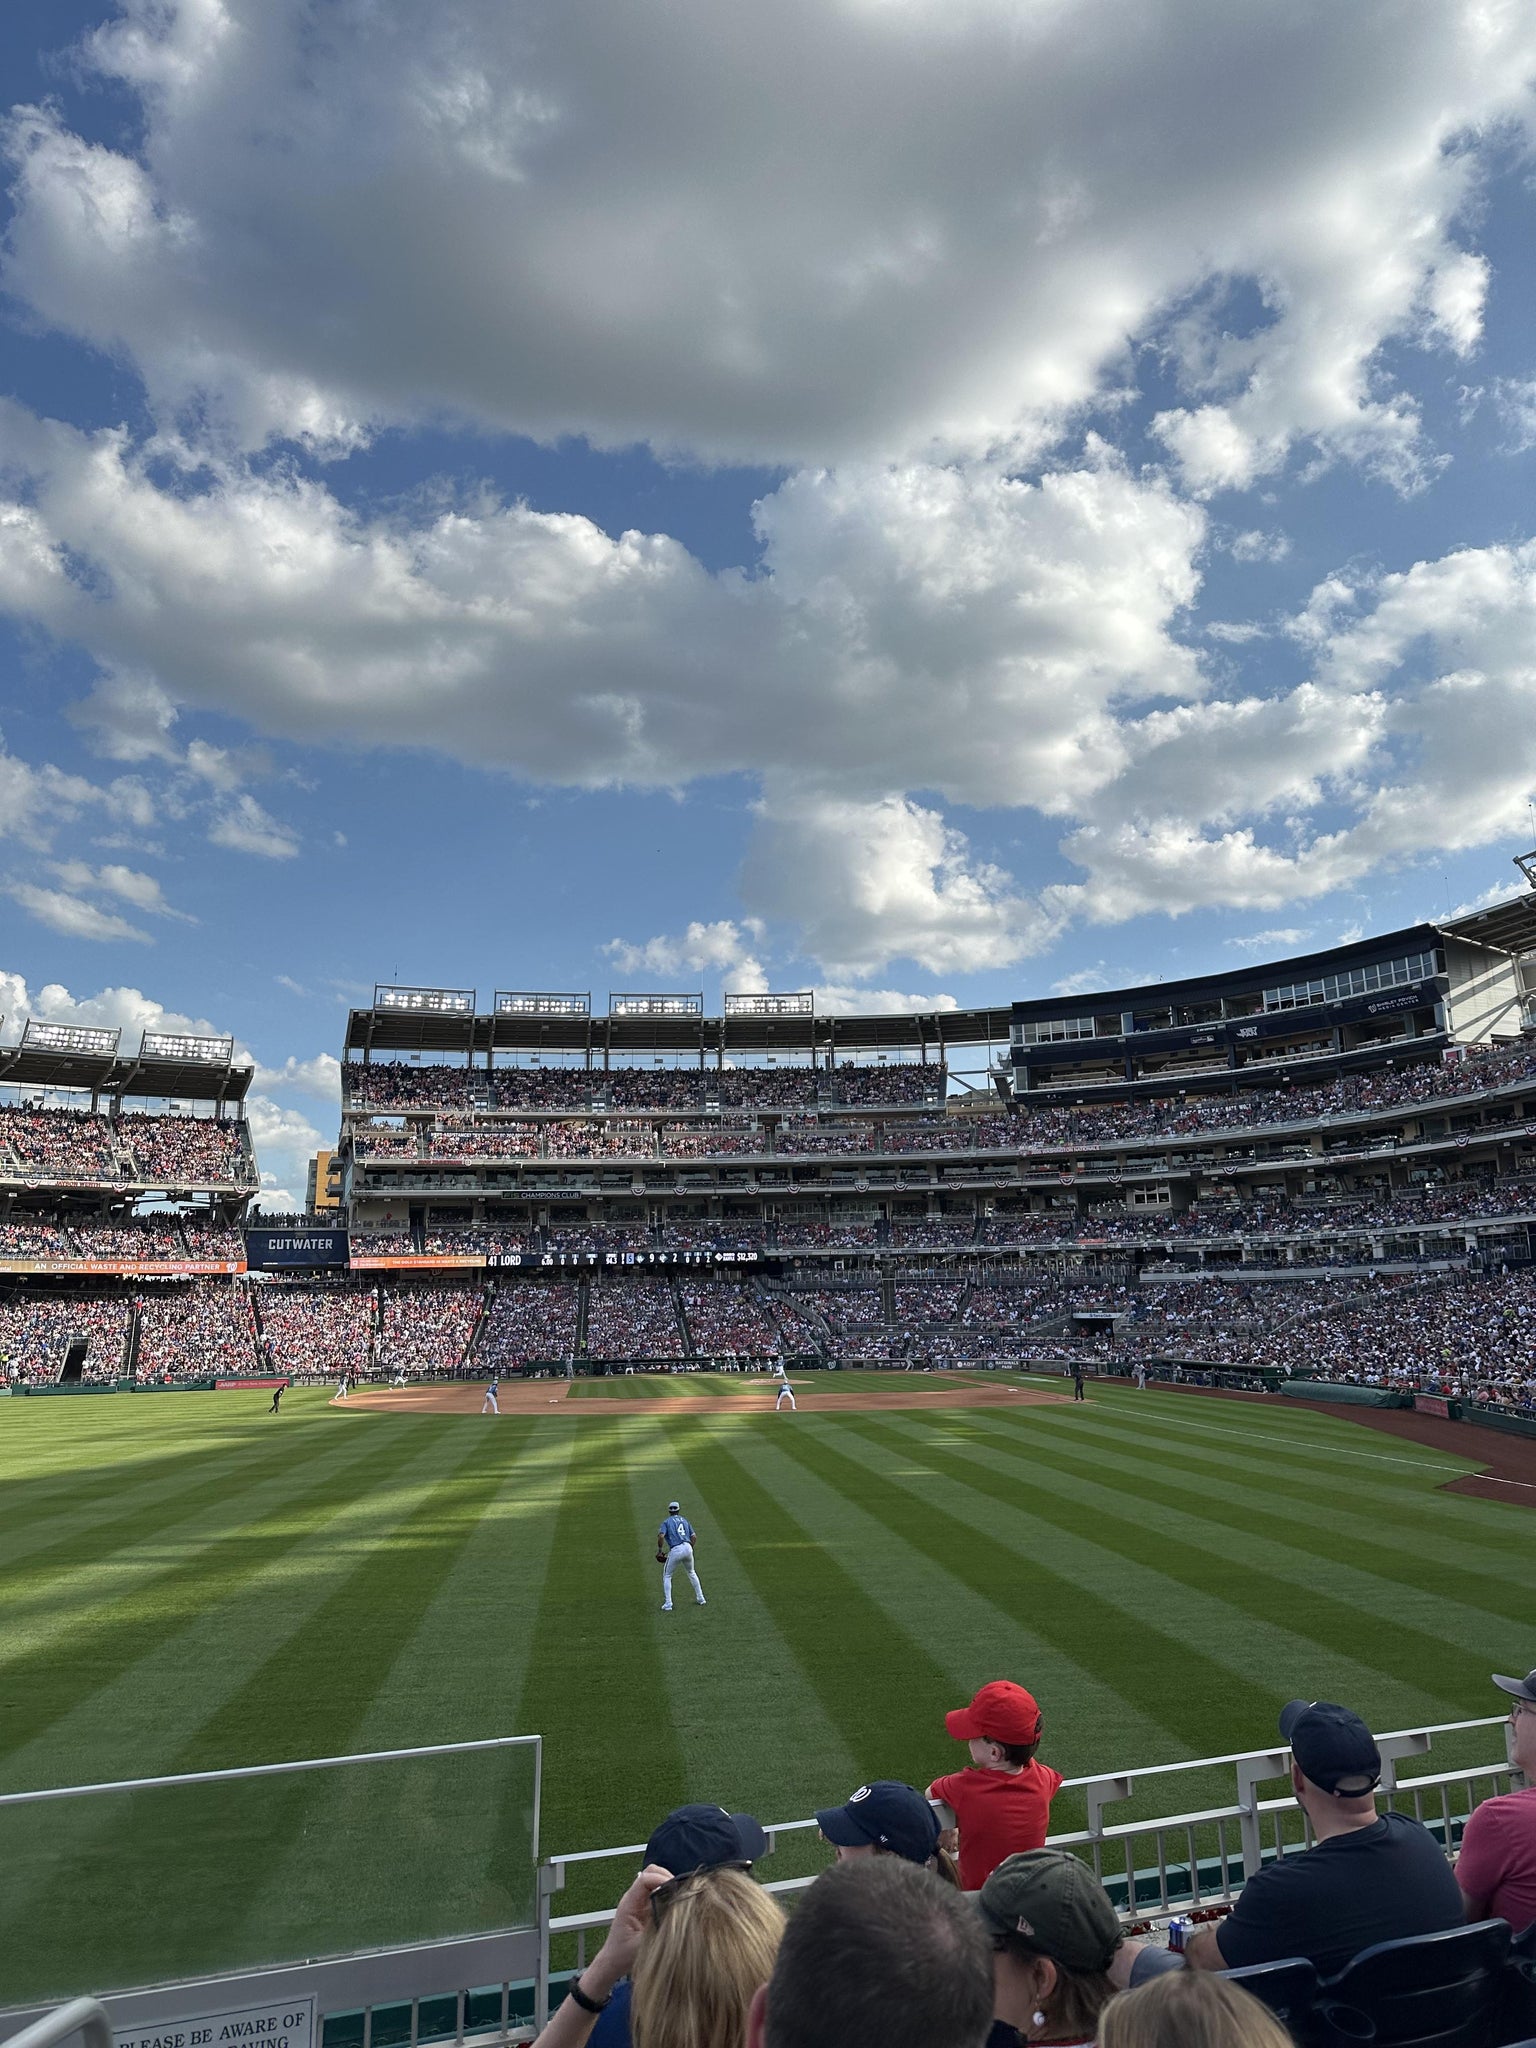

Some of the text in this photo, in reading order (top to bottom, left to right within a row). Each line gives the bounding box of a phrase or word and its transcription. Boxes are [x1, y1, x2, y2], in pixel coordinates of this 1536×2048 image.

[268, 1239, 333, 1250] CUTWATER
[488, 1255, 521, 1266] 41 LORD
[649, 1253, 655, 1263] 9
[672, 1252, 678, 1263] 2
[1111, 1252, 1130, 1260] PNC
[138, 1263, 184, 1271] RECYCLING
[185, 1263, 220, 1271] PARTNER
[677, 1523, 686, 1536] 4
[119, 2012, 306, 2048] EASE BE AWARE OF
